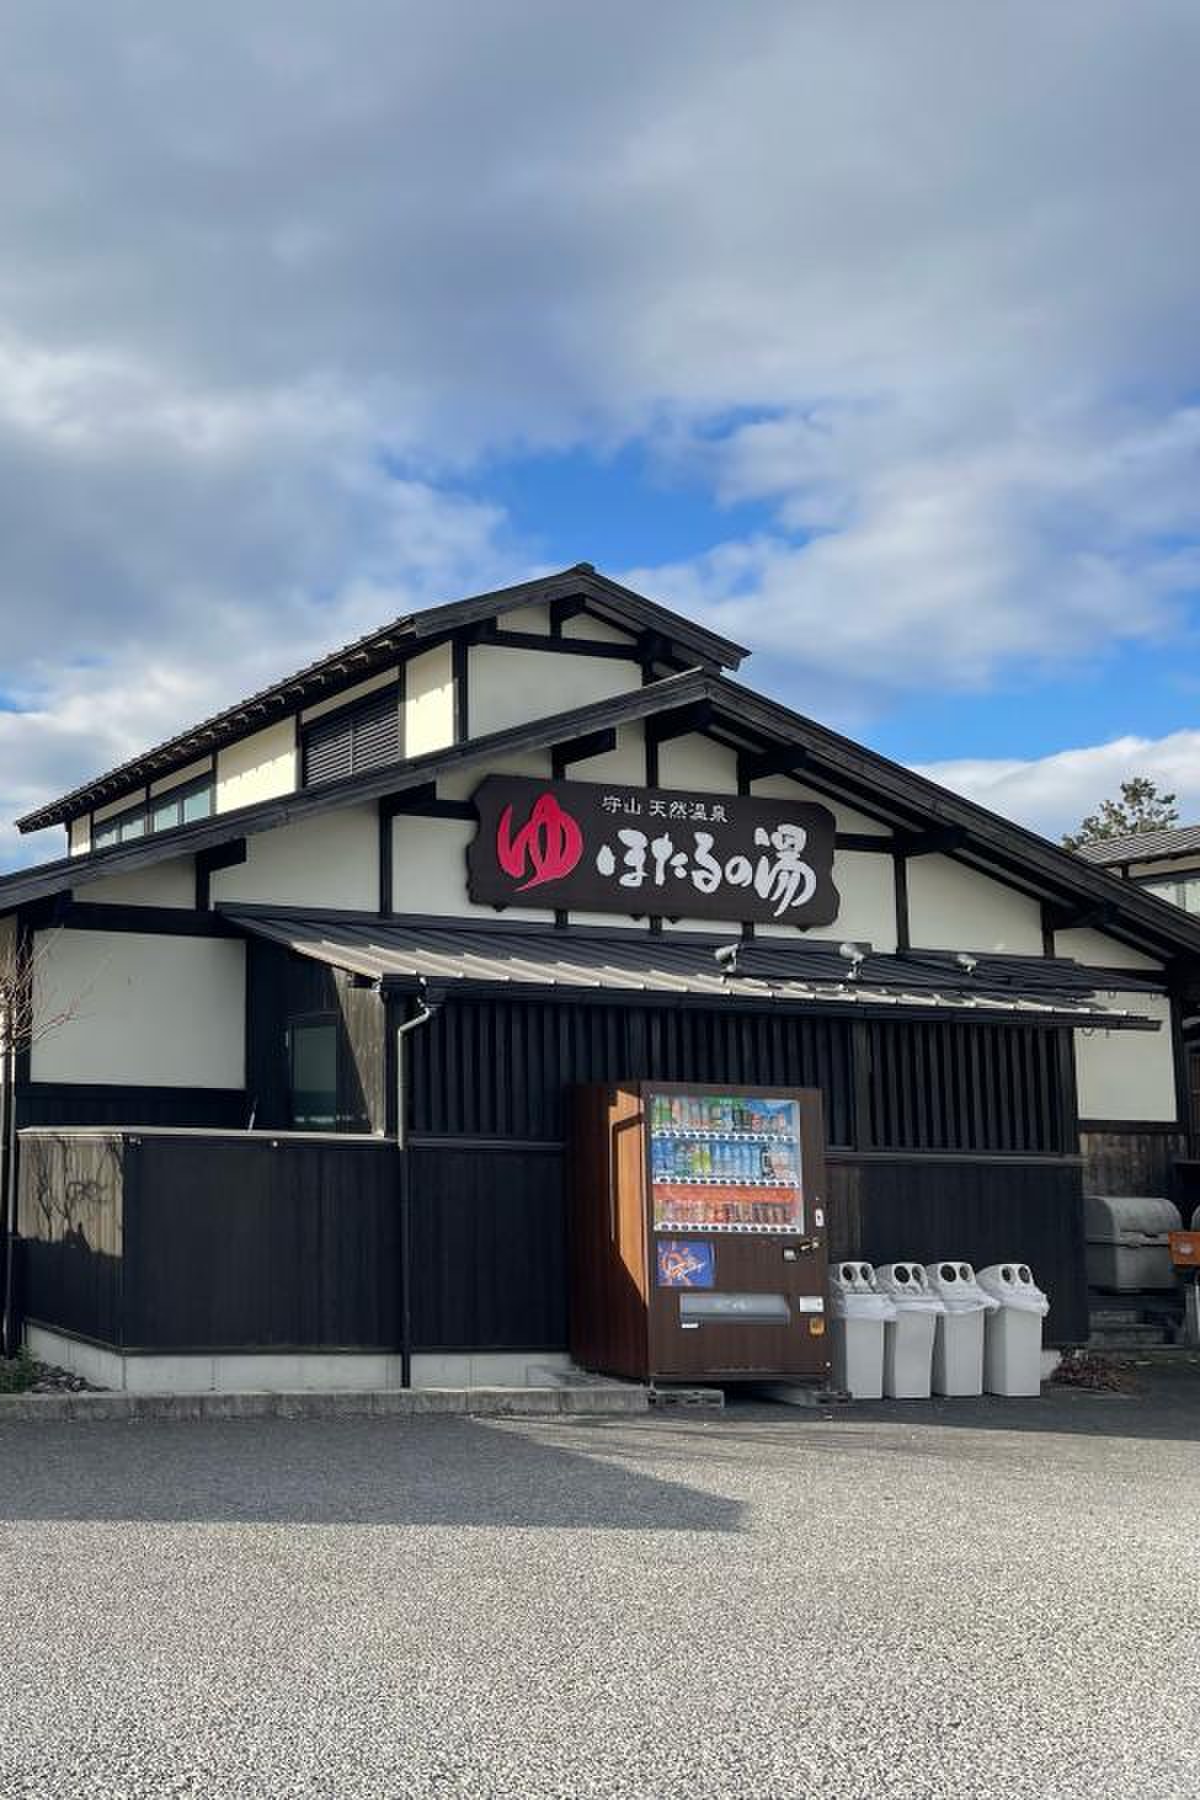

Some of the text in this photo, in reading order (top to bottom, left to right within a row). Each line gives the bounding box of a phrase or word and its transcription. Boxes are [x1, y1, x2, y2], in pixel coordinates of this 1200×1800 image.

[497, 793, 583, 892] ゆ
[649, 799, 728, 823] 天然温泉
[596, 824, 816, 916] ほたるの湯
